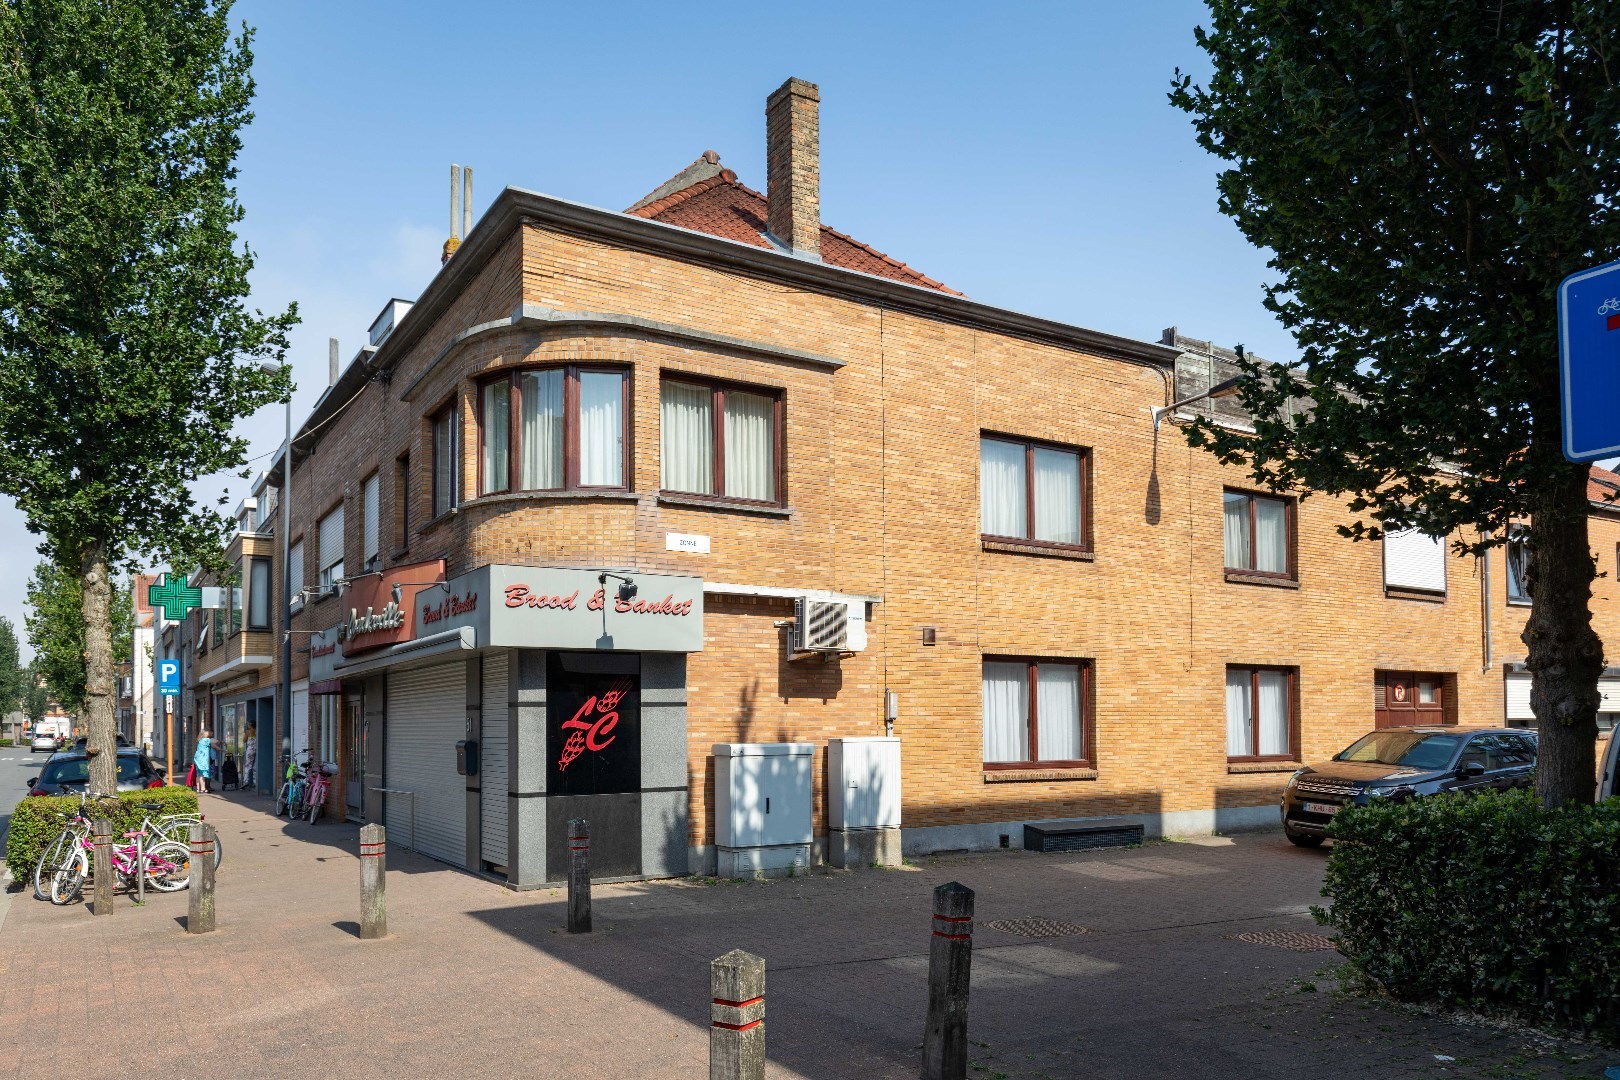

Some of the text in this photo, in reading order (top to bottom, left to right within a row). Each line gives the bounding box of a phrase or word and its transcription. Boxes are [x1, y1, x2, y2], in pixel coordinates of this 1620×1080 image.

[504, 583, 693, 617] Brood & Banket
[161, 664, 177, 683] P
